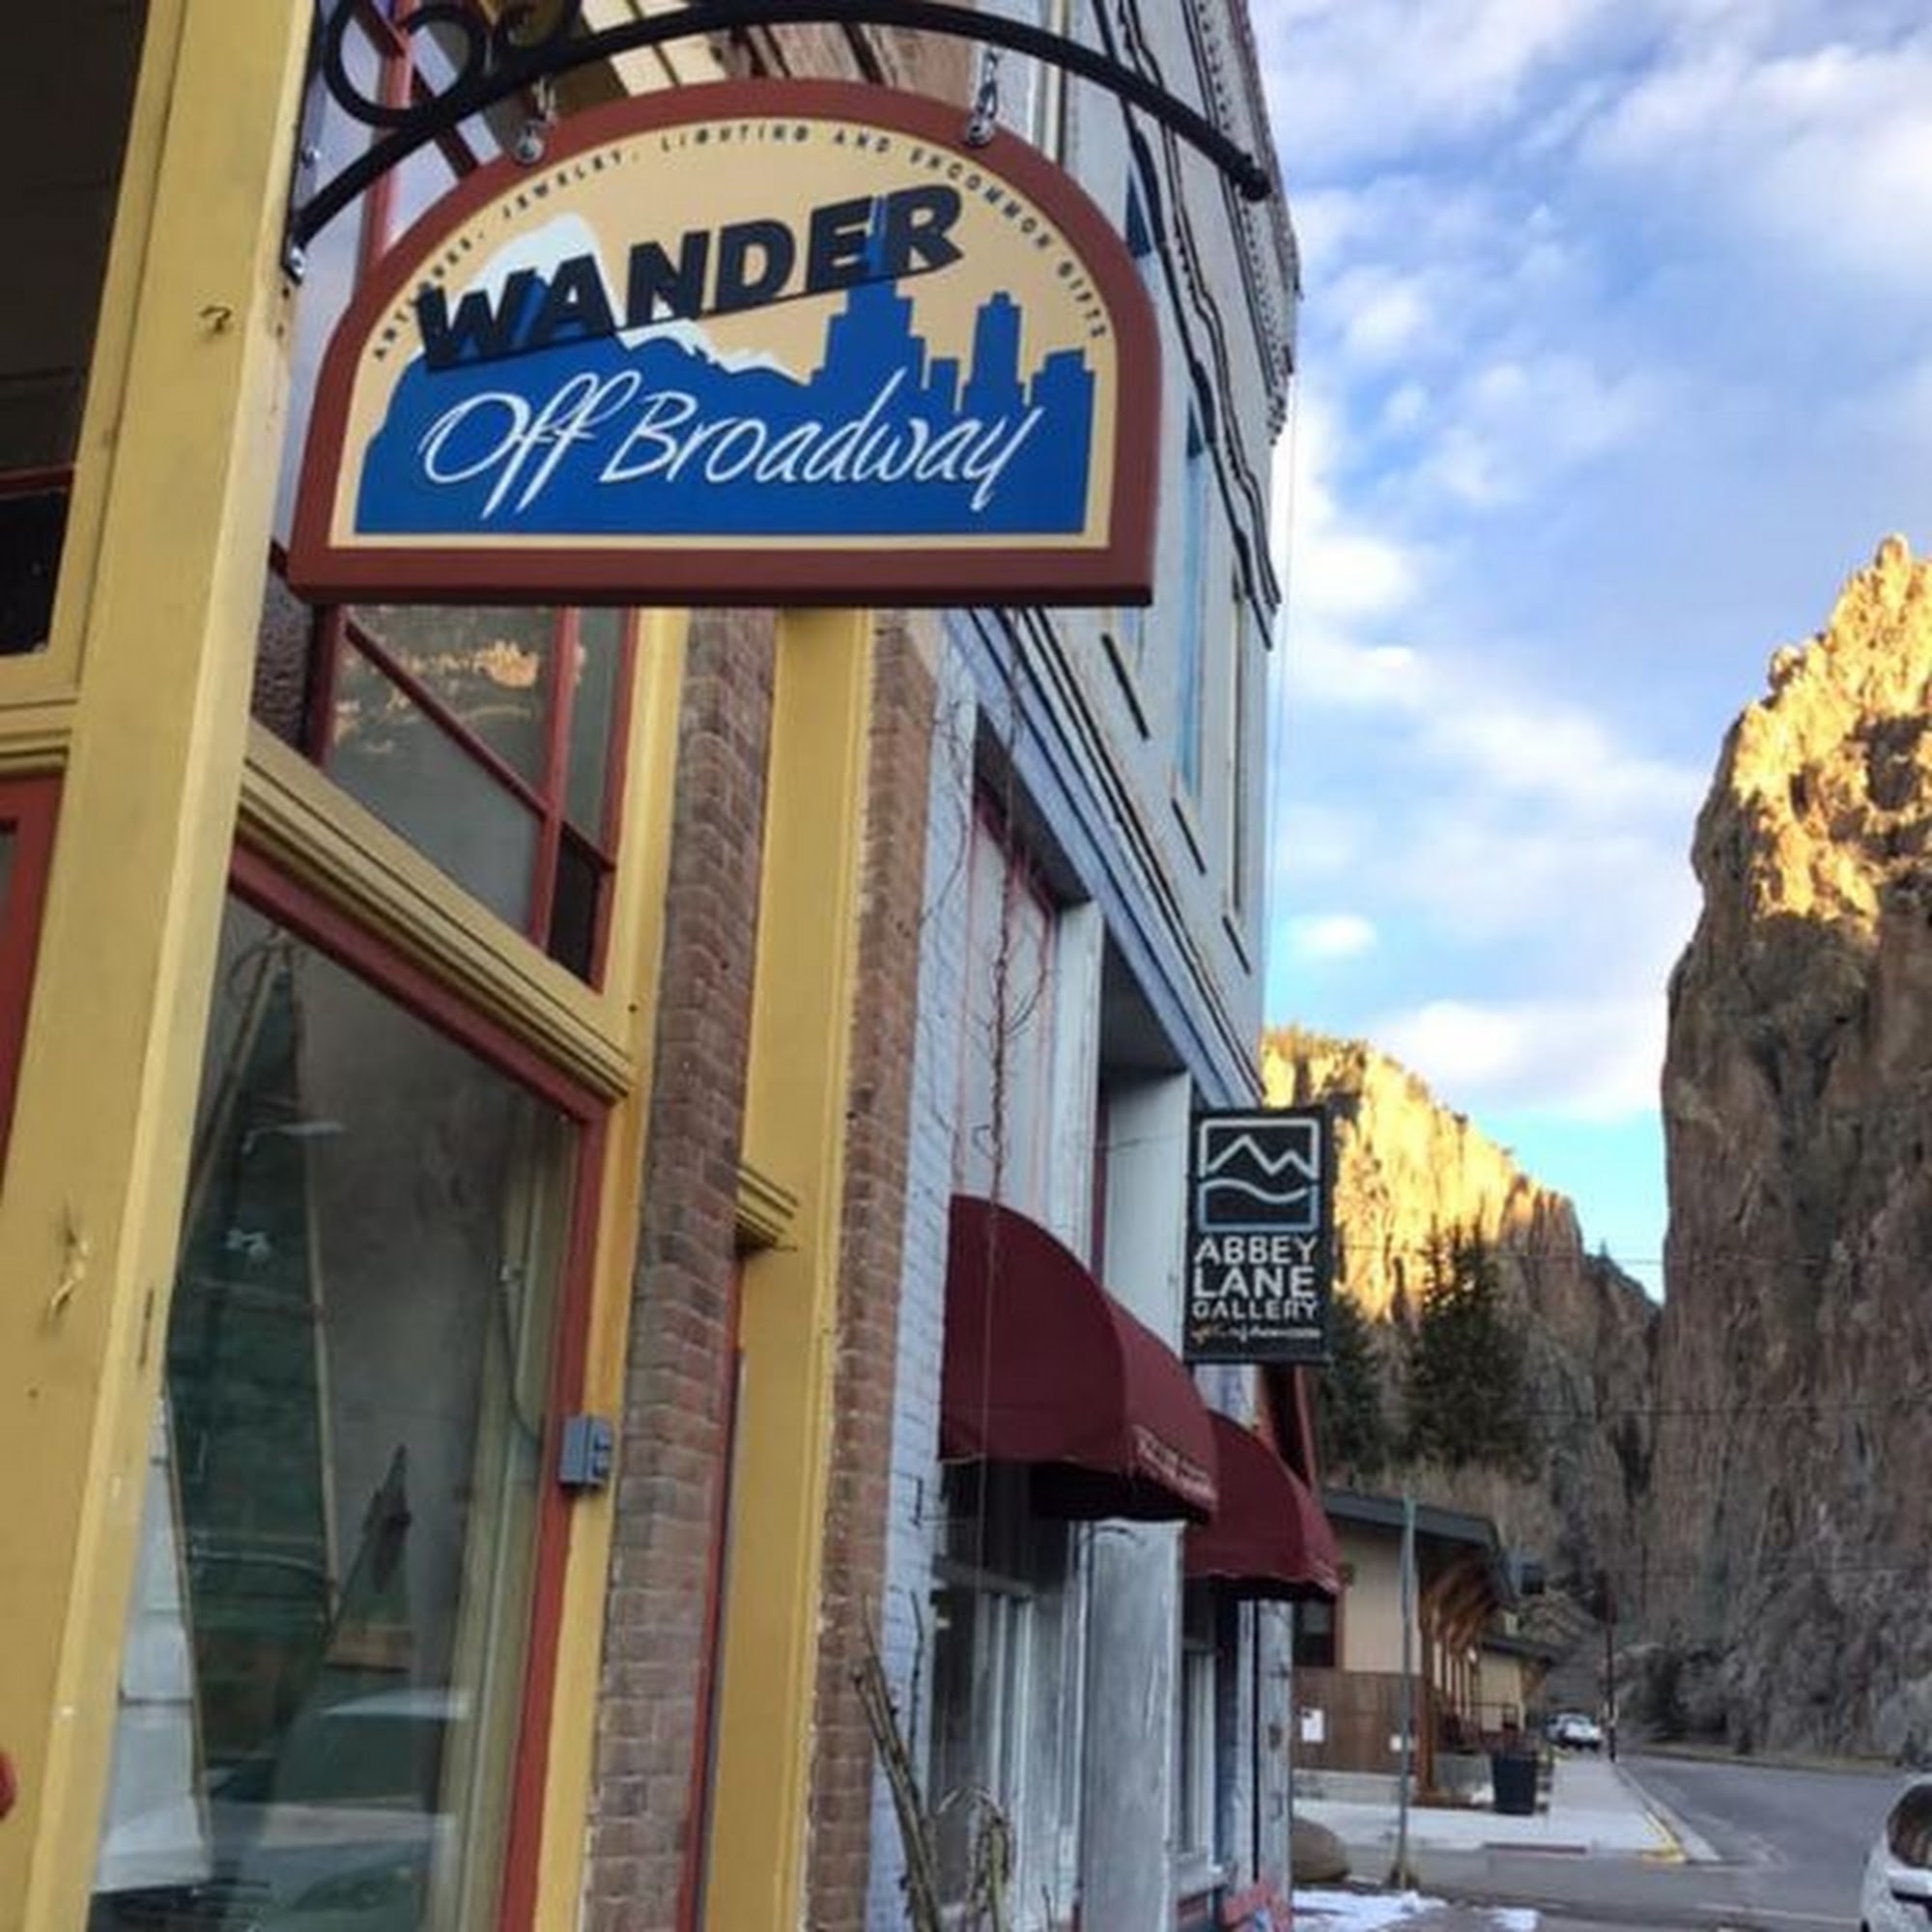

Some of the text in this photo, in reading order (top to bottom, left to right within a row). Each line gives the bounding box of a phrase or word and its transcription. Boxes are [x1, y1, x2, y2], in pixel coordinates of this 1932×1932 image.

[415, 184, 964, 372] WANDER
[832, 128, 892, 154] AND
[1058, 261, 1107, 338] GIFTS
[417, 366, 1045, 520] Off Broadway
[1192, 1265, 1316, 1298] LANE
[1193, 1235, 1318, 1264] ABBEY
[1191, 1299, 1319, 1321] GALLERY
